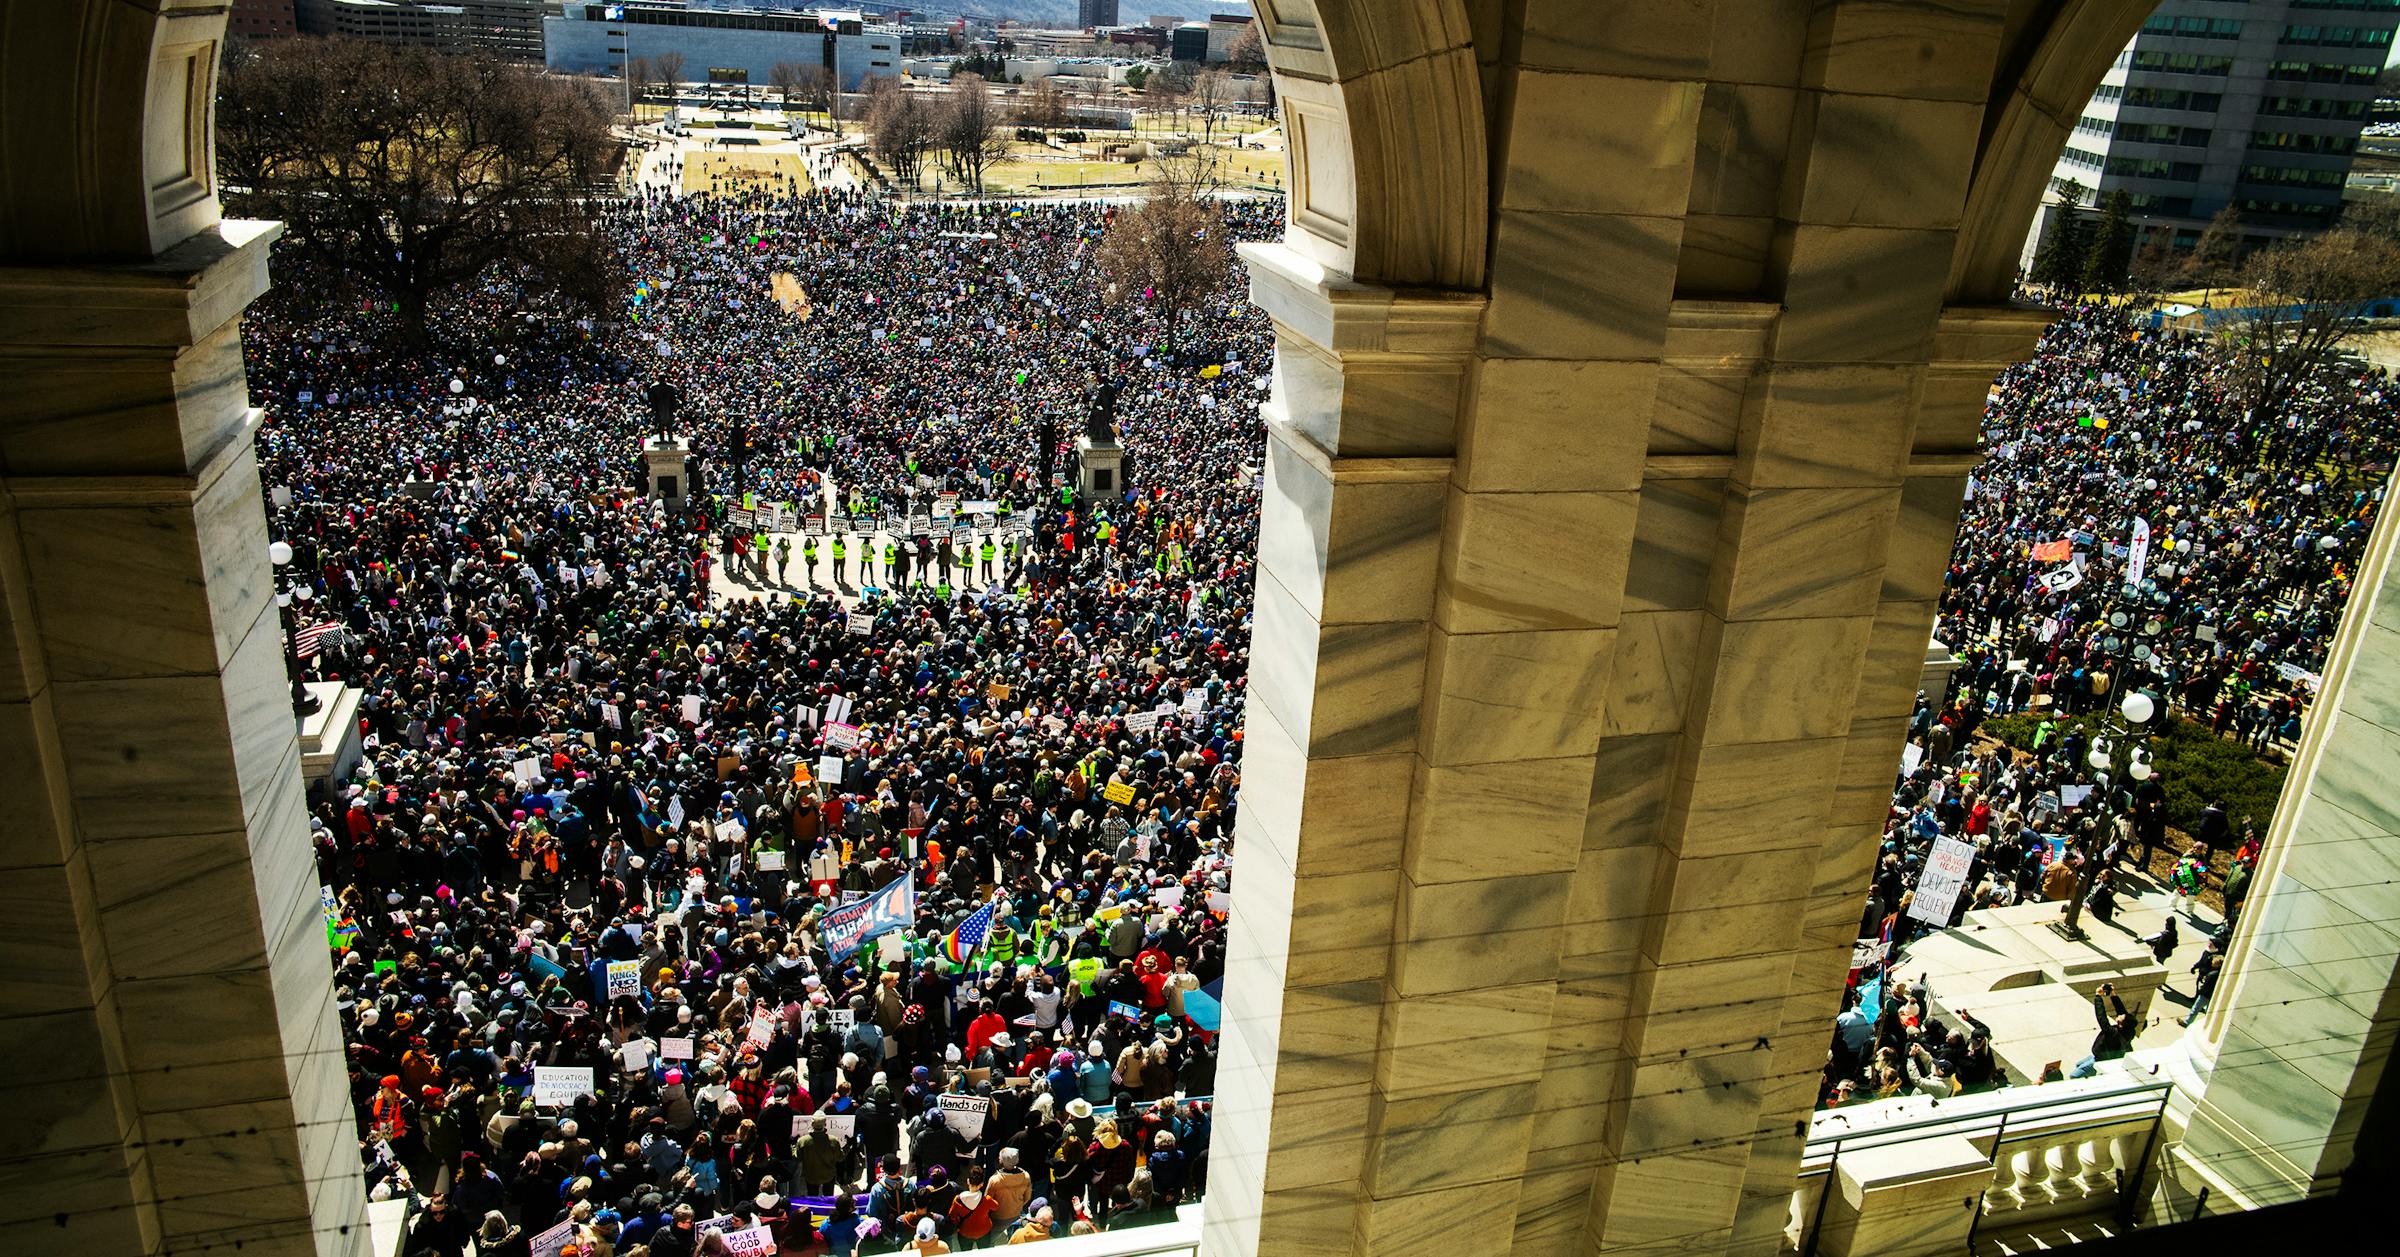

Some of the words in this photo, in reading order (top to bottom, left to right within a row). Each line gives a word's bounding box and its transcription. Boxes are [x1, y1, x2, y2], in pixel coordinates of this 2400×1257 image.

[1935, 838, 1972, 860] ELON
[1936, 852, 1968, 870] ORANGE
[1940, 862, 1961, 874] HEAD
[609, 963, 637, 972] NO
[610, 971, 637, 980] KINGS
[610, 979, 637, 988] NO
[611, 985, 638, 995] FASCISTS
[540, 1082, 588, 1090] DEMOCRACY
[940, 1099, 970, 1109] Hands
[972, 1102, 987, 1111] off
[831, 1120, 849, 1131] Buy
[696, 1217, 733, 1231] FASCIS
[729, 1231, 758, 1243] MAKE
[732, 1239, 760, 1251] GOOD
